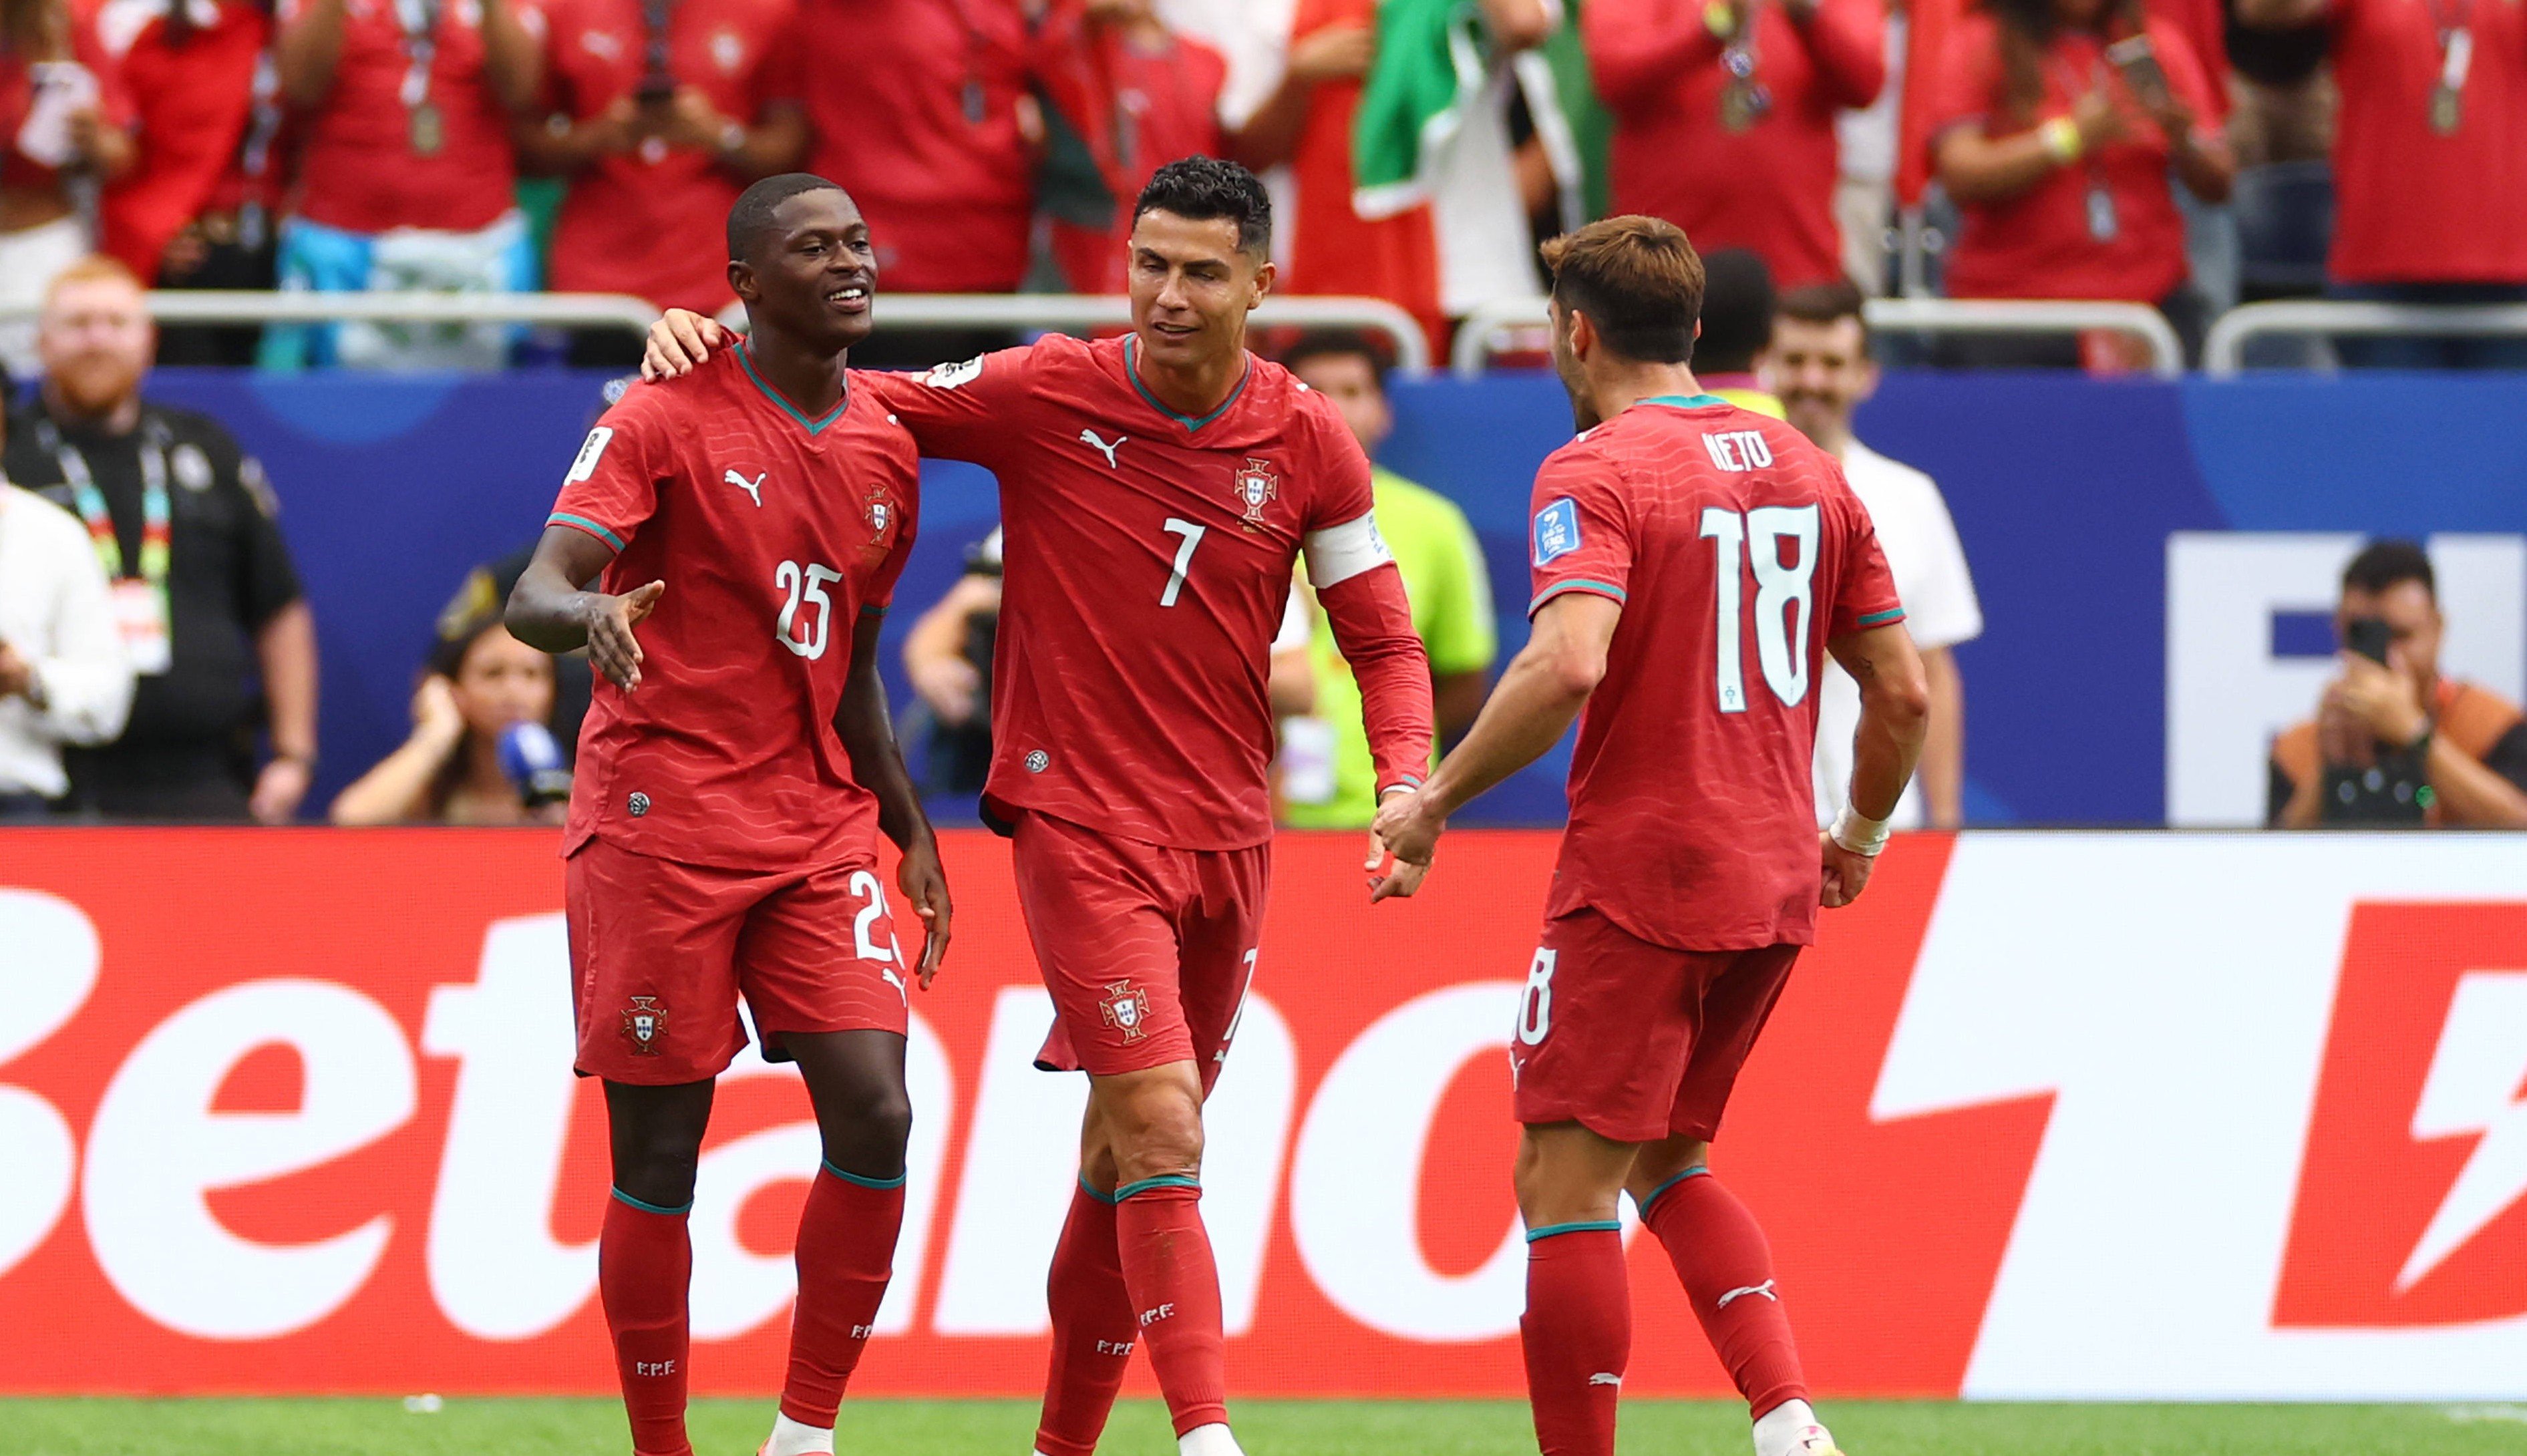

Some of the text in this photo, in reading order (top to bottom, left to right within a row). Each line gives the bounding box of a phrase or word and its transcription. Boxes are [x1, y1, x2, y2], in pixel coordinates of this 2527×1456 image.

[1701, 430, 1774, 472] NETO
[776, 560, 844, 661] 25
[1160, 518, 1206, 607] 7
[1699, 502, 1820, 713] 18
[1512, 946, 1557, 1046] 8
